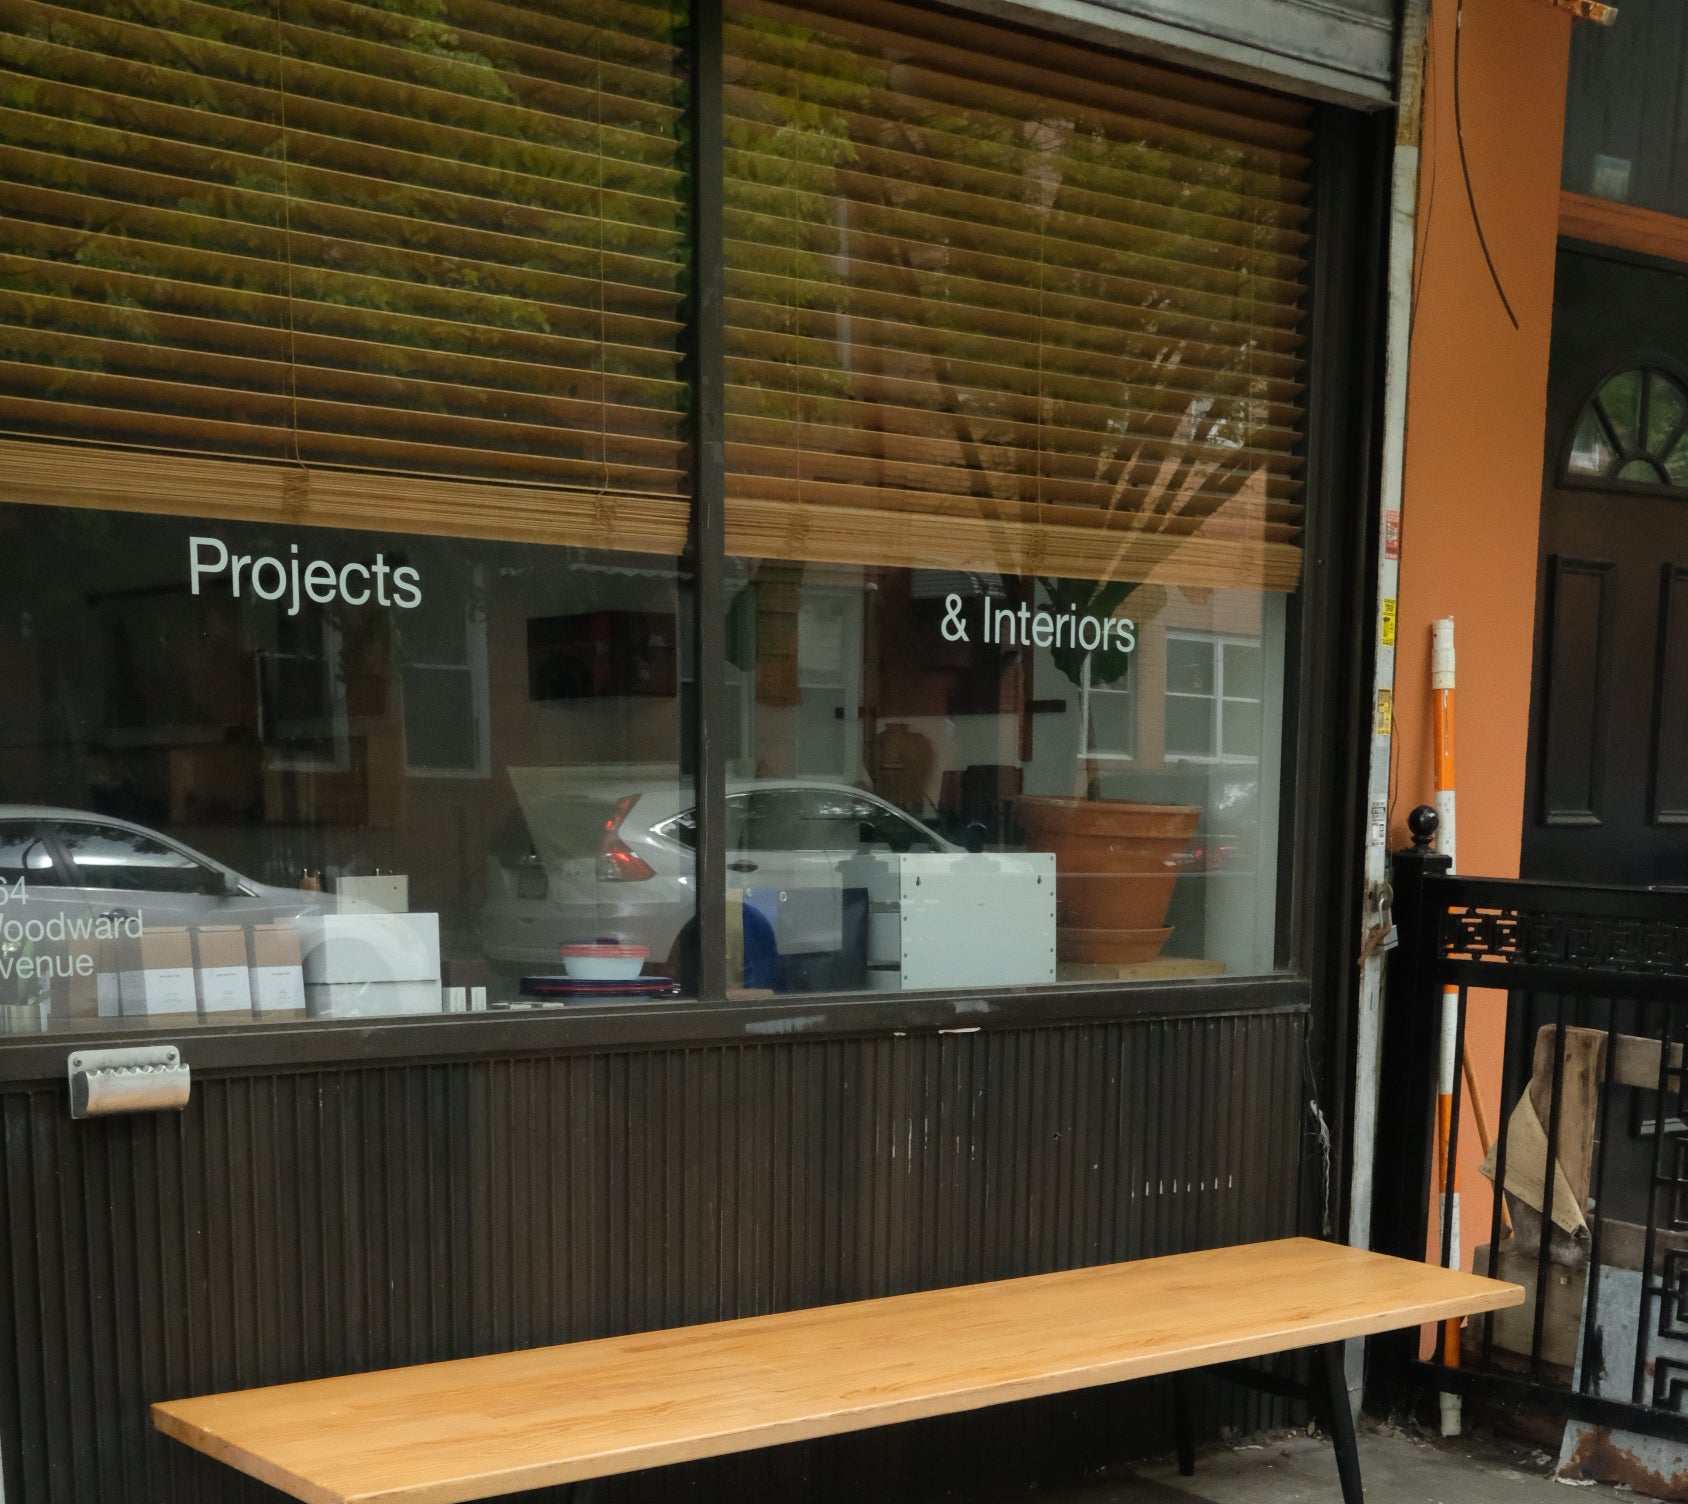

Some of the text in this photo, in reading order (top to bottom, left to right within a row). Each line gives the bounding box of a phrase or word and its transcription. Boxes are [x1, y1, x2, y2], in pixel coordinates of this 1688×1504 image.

[189, 536, 422, 616] Projects
[941, 593, 1136, 653] & Interiors
[0, 909, 144, 942] oodward
[0, 953, 94, 979] venue
